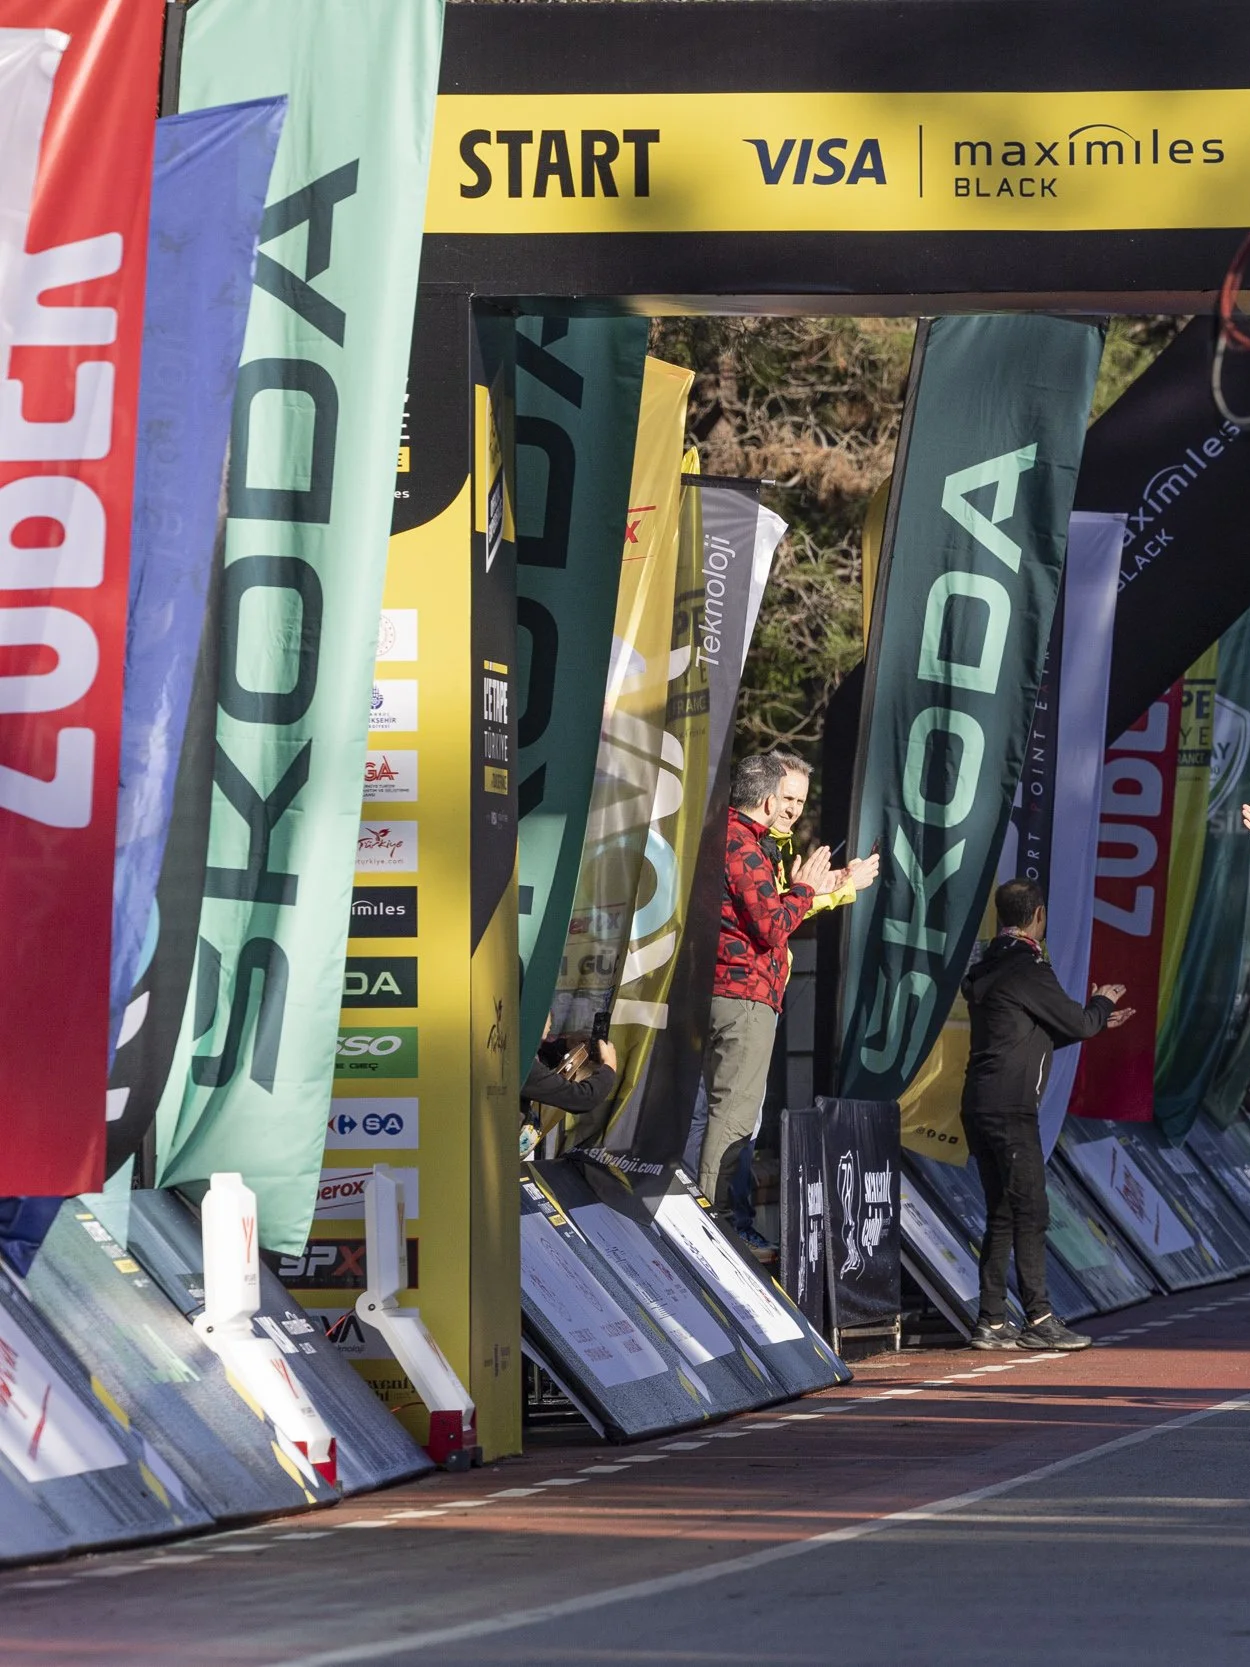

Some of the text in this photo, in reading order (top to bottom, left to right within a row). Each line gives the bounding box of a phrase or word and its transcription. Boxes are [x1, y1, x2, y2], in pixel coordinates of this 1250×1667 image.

[459, 128, 661, 199] START
[742, 138, 887, 186] VISA
[953, 123, 1225, 167] maximiles
[954, 176, 1059, 198] BLACK
[695, 534, 737, 668] Teknoloji
[349, 1062, 379, 1071] GEÇ
